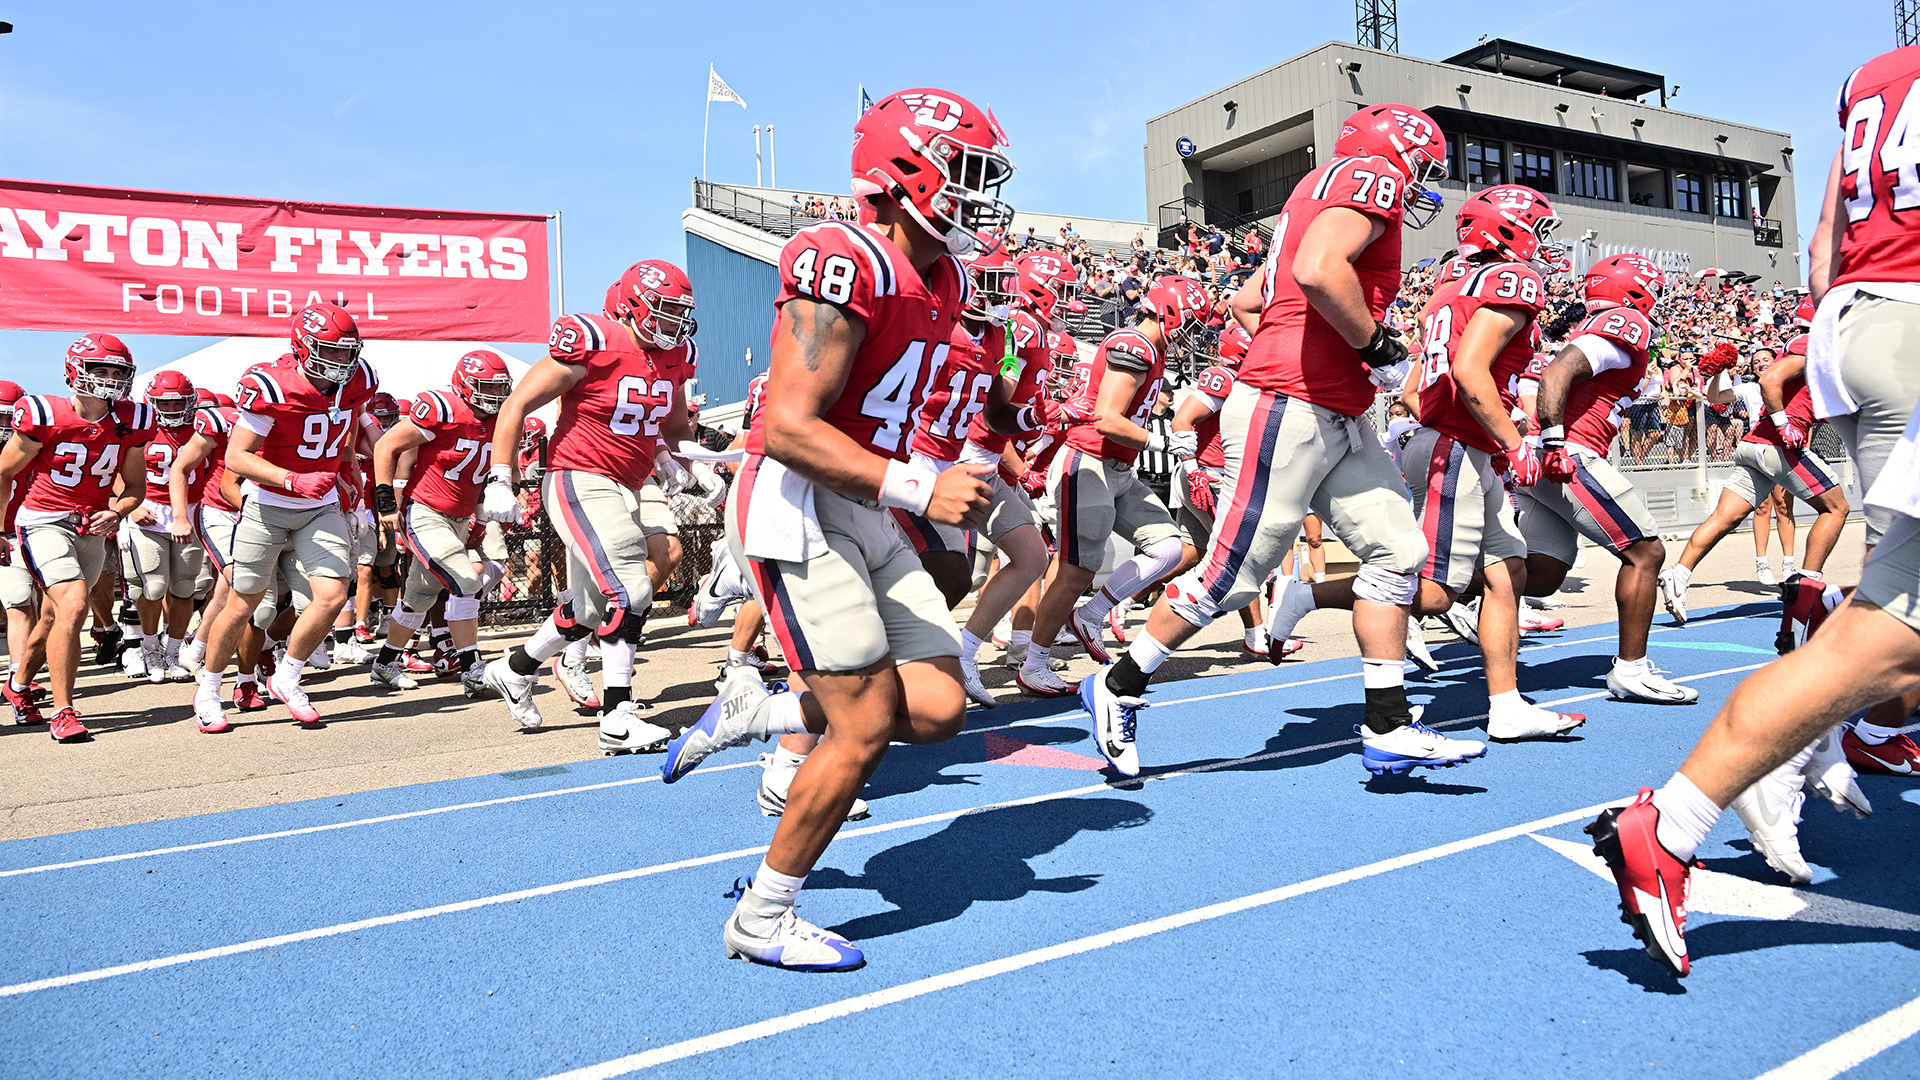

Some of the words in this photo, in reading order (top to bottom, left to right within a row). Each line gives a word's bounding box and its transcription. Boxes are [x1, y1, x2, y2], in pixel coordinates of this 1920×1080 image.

[1351, 169, 1397, 211] 78
[263, 225, 529, 281] FLYERS
[791, 247, 859, 306] 48
[1496, 270, 1539, 305] 38
[549, 323, 578, 354] 62
[1601, 313, 1643, 346] 23
[929, 369, 993, 440] 16
[1199, 371, 1226, 393] 36
[410, 394, 431, 421] 70
[608, 374, 674, 437] 62
[297, 408, 344, 461] 97
[49, 441, 121, 489] 34
